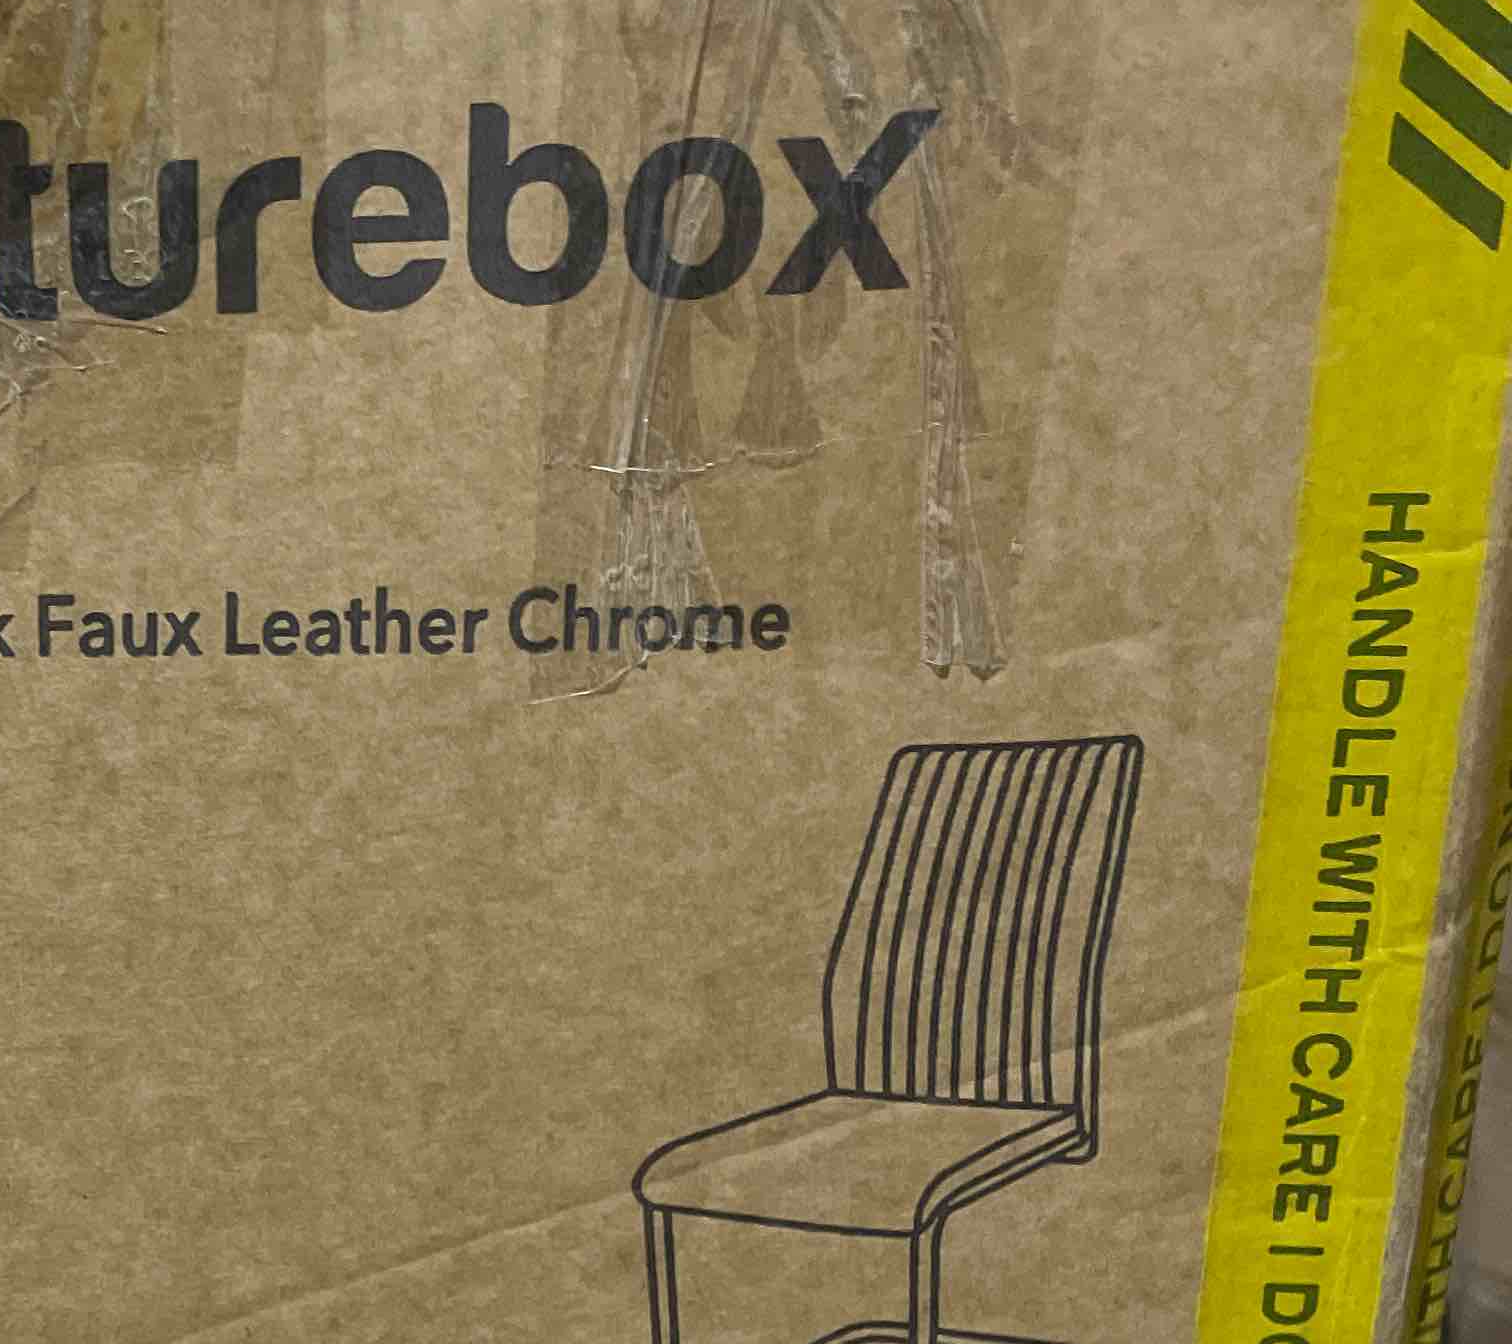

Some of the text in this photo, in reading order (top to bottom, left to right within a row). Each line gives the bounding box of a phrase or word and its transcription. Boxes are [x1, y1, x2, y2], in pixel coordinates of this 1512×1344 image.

[33, 592, 201, 661] Faux
[222, 587, 490, 659] Leather
[507, 585, 793, 658] Chrome
[1324, 491, 1432, 819] HANDLE
[1298, 833, 1383, 1014] WITH
[1273, 1032, 1354, 1223] CARE
